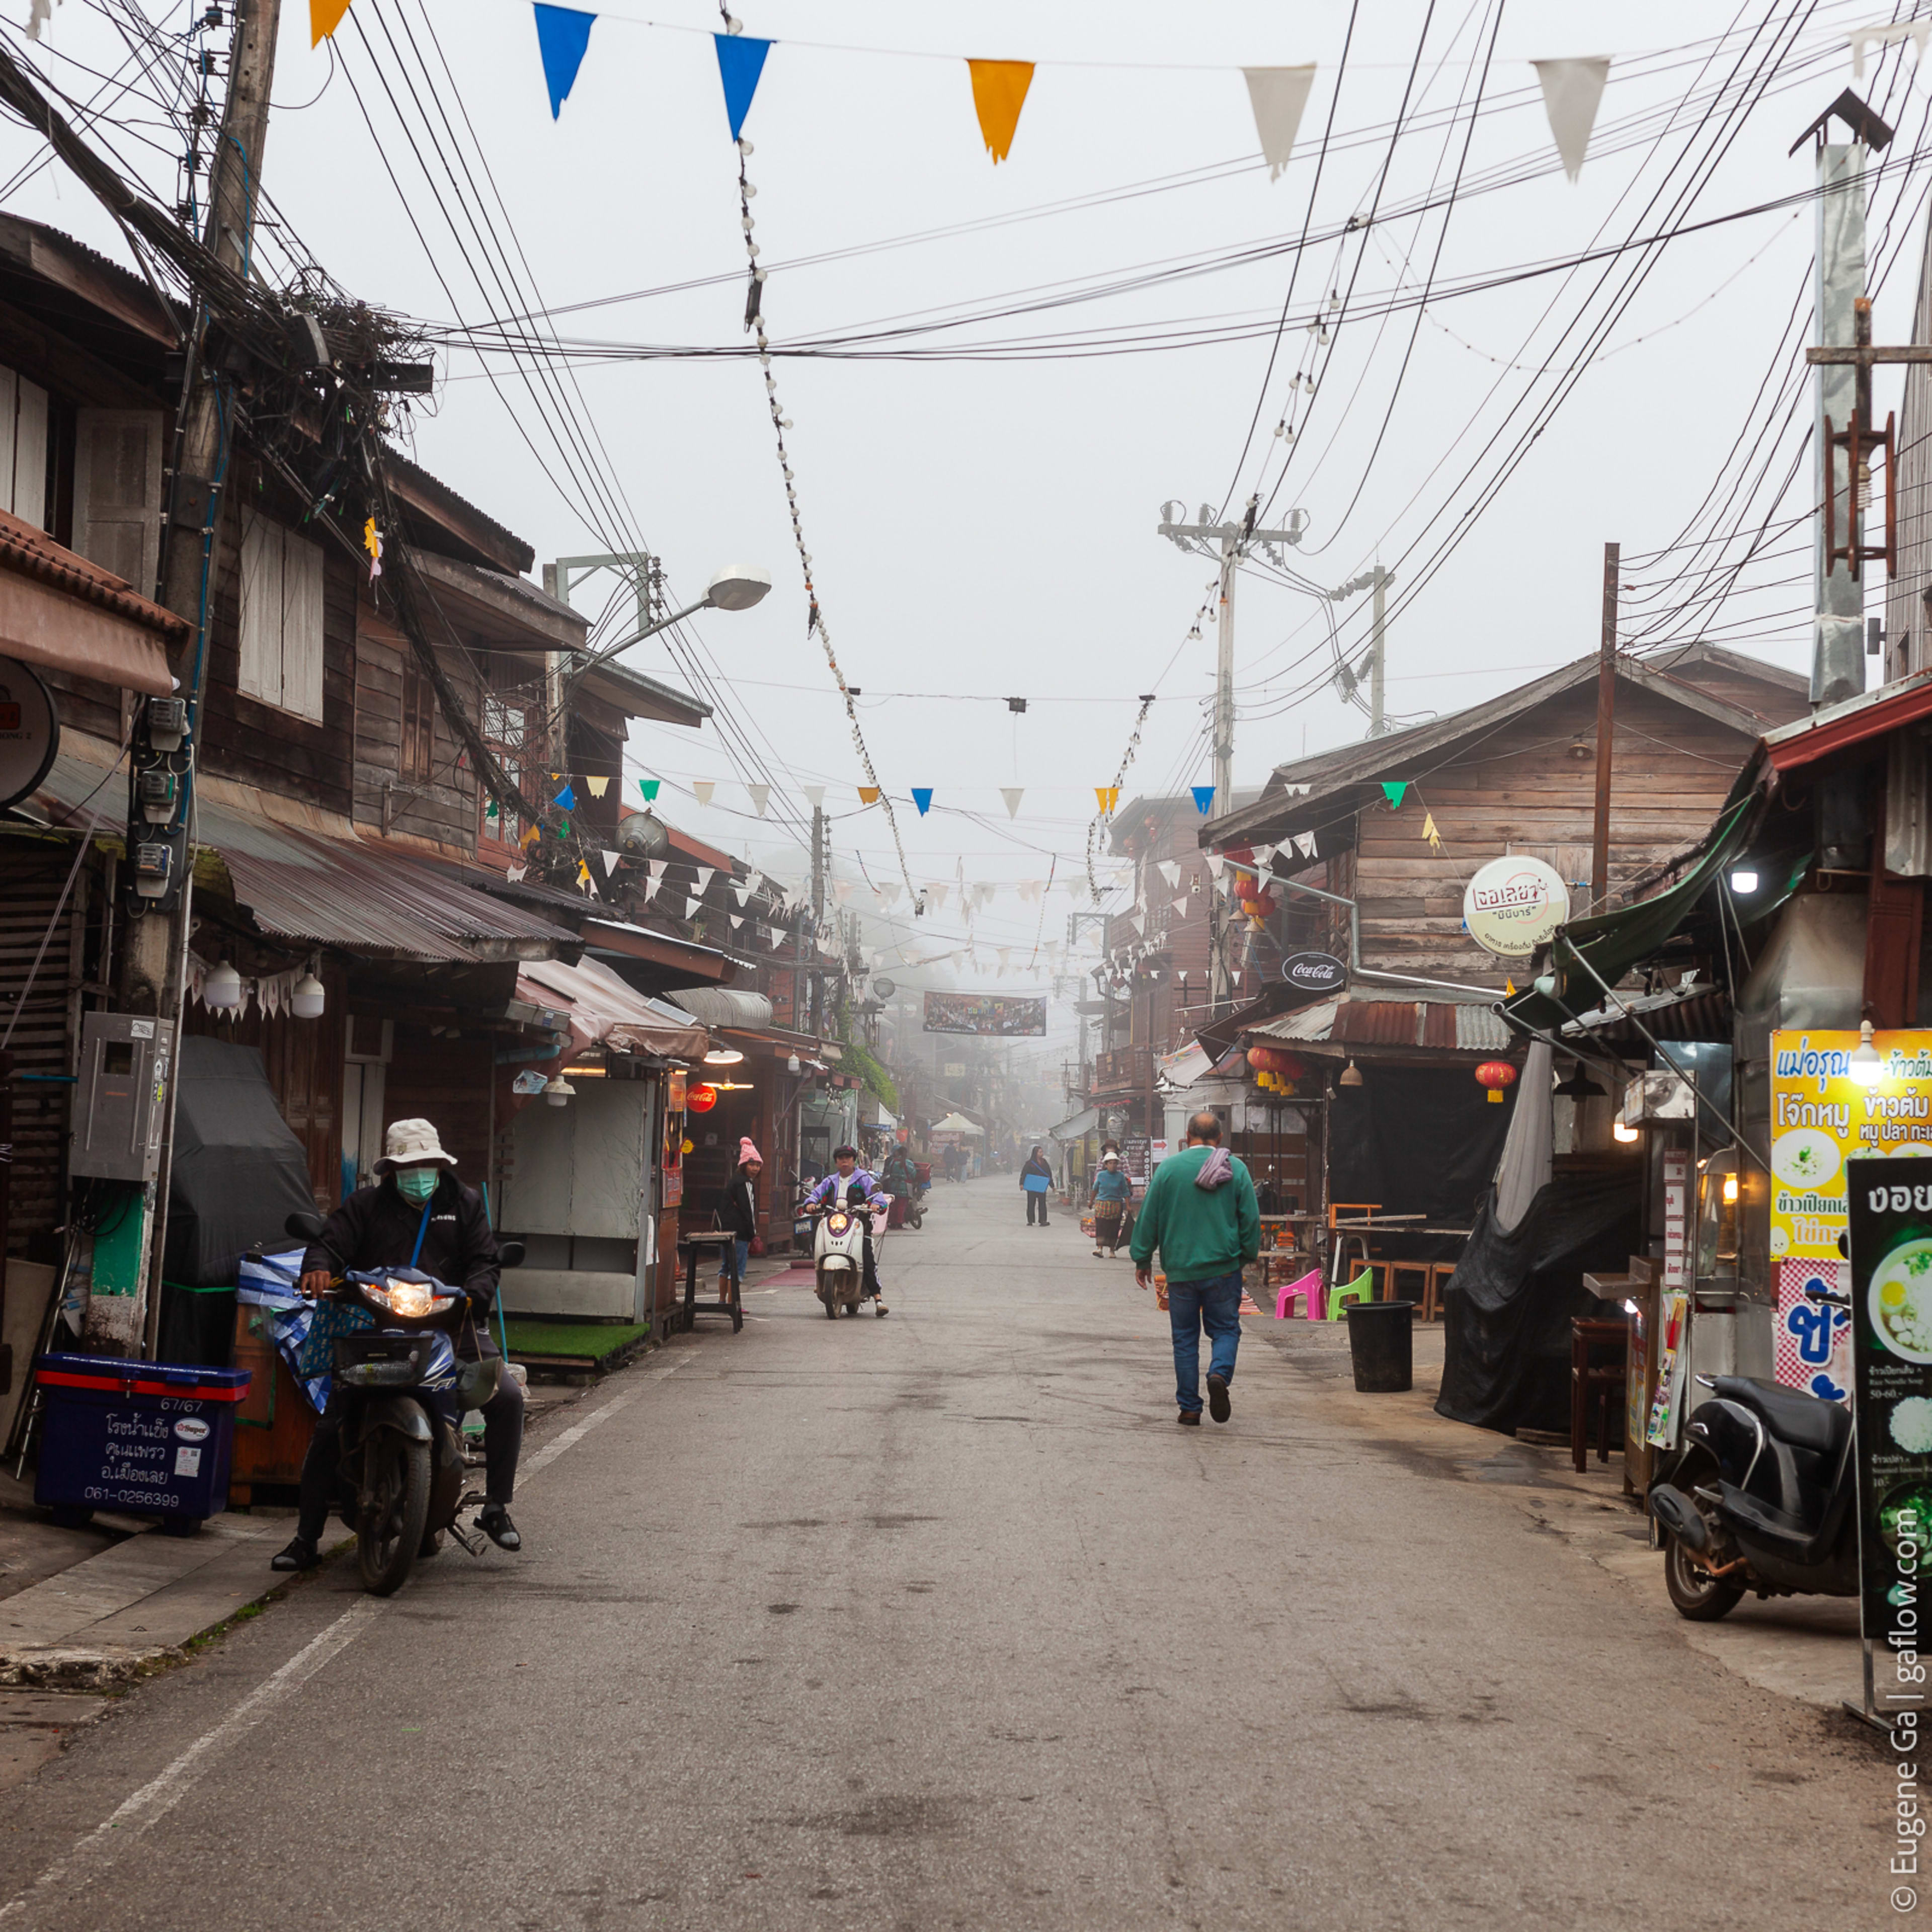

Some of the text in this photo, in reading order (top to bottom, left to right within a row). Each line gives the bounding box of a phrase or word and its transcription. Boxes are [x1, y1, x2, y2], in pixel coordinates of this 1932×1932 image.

[1778, 1038, 1850, 1091] แม่อรุณ
[1777, 1092, 1850, 1139] โจ๊กหมู
[1863, 1087, 1929, 1118] ข้าวต้ม
[1860, 1118, 1932, 1147] หมู ปลา ทะเ
[1794, 1219, 1848, 1243] ไข่กะ
[160, 1398, 203, 1412] 67/67
[106, 1412, 169, 1439] โรงน้ำแข็ง
[85, 1486, 180, 1508] 061-0256399
